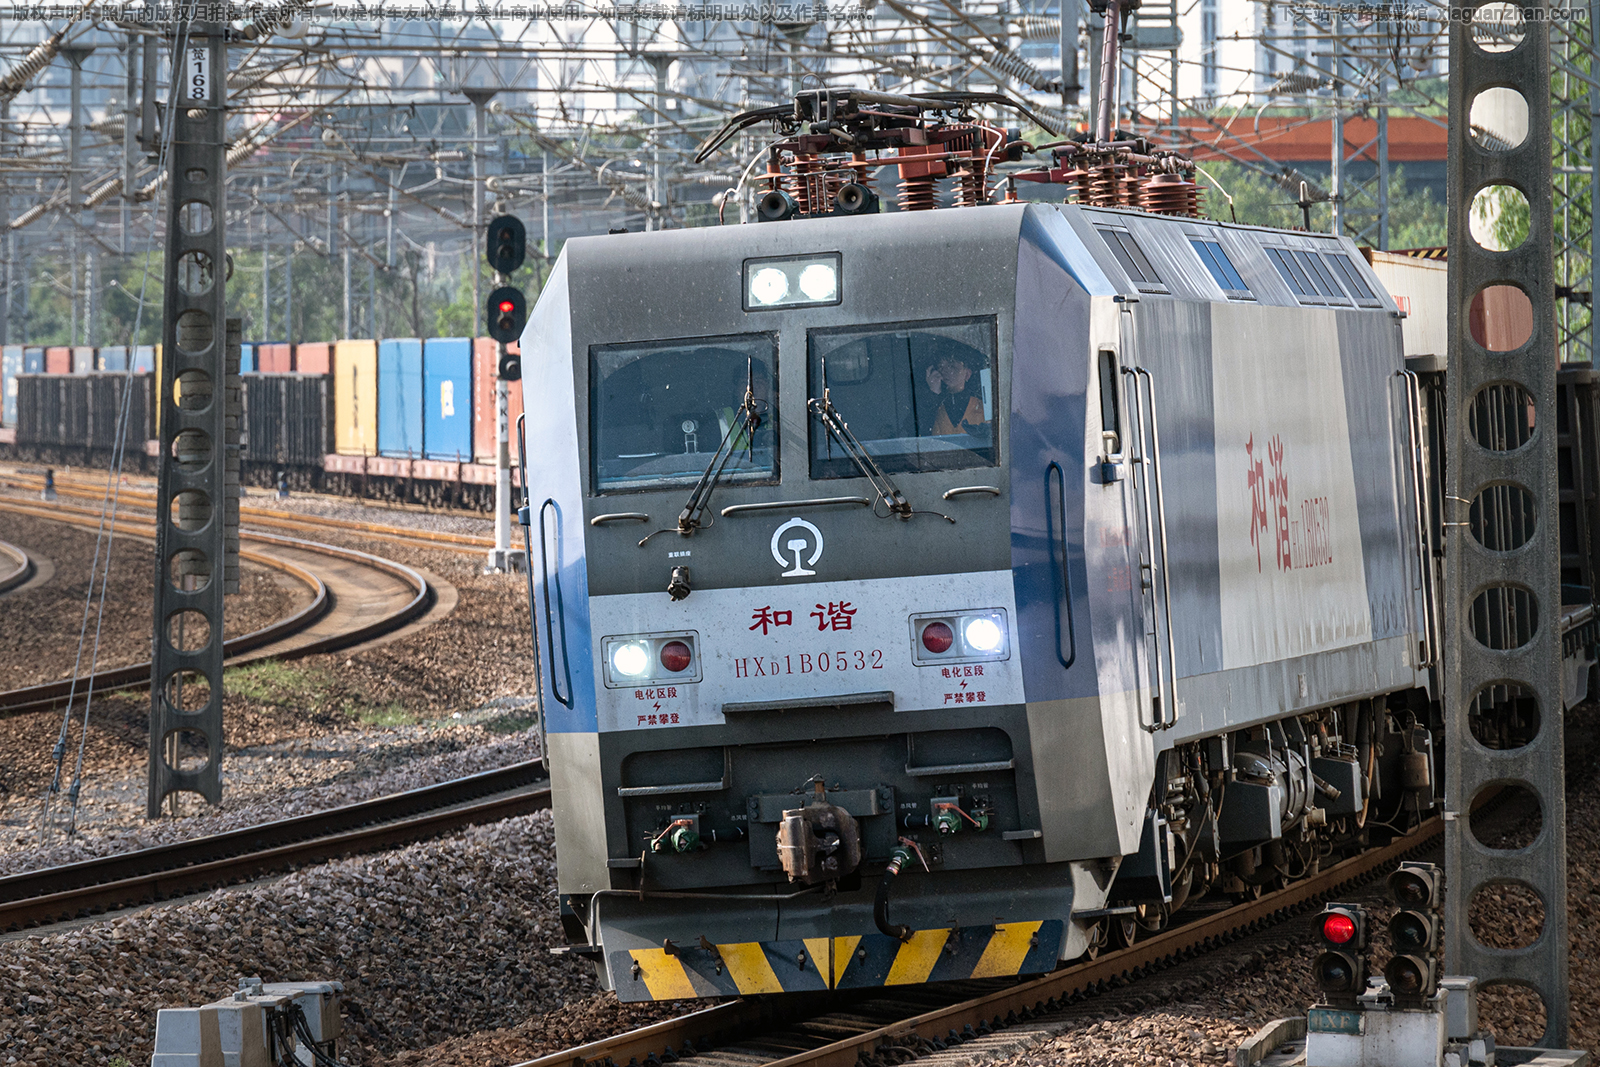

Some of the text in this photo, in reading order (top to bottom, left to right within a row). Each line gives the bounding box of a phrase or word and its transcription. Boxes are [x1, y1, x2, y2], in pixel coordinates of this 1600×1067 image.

[1245, 431, 1292, 574] 和谐
[748, 601, 858, 636] 和谐
[734, 648, 884, 679] HXD1B0532
[941, 664, 984, 679] 电化区段
[634, 686, 678, 700] 电化区段
[943, 690, 987, 705] 严禁攀登
[636, 712, 680, 727] 严禁攀登
